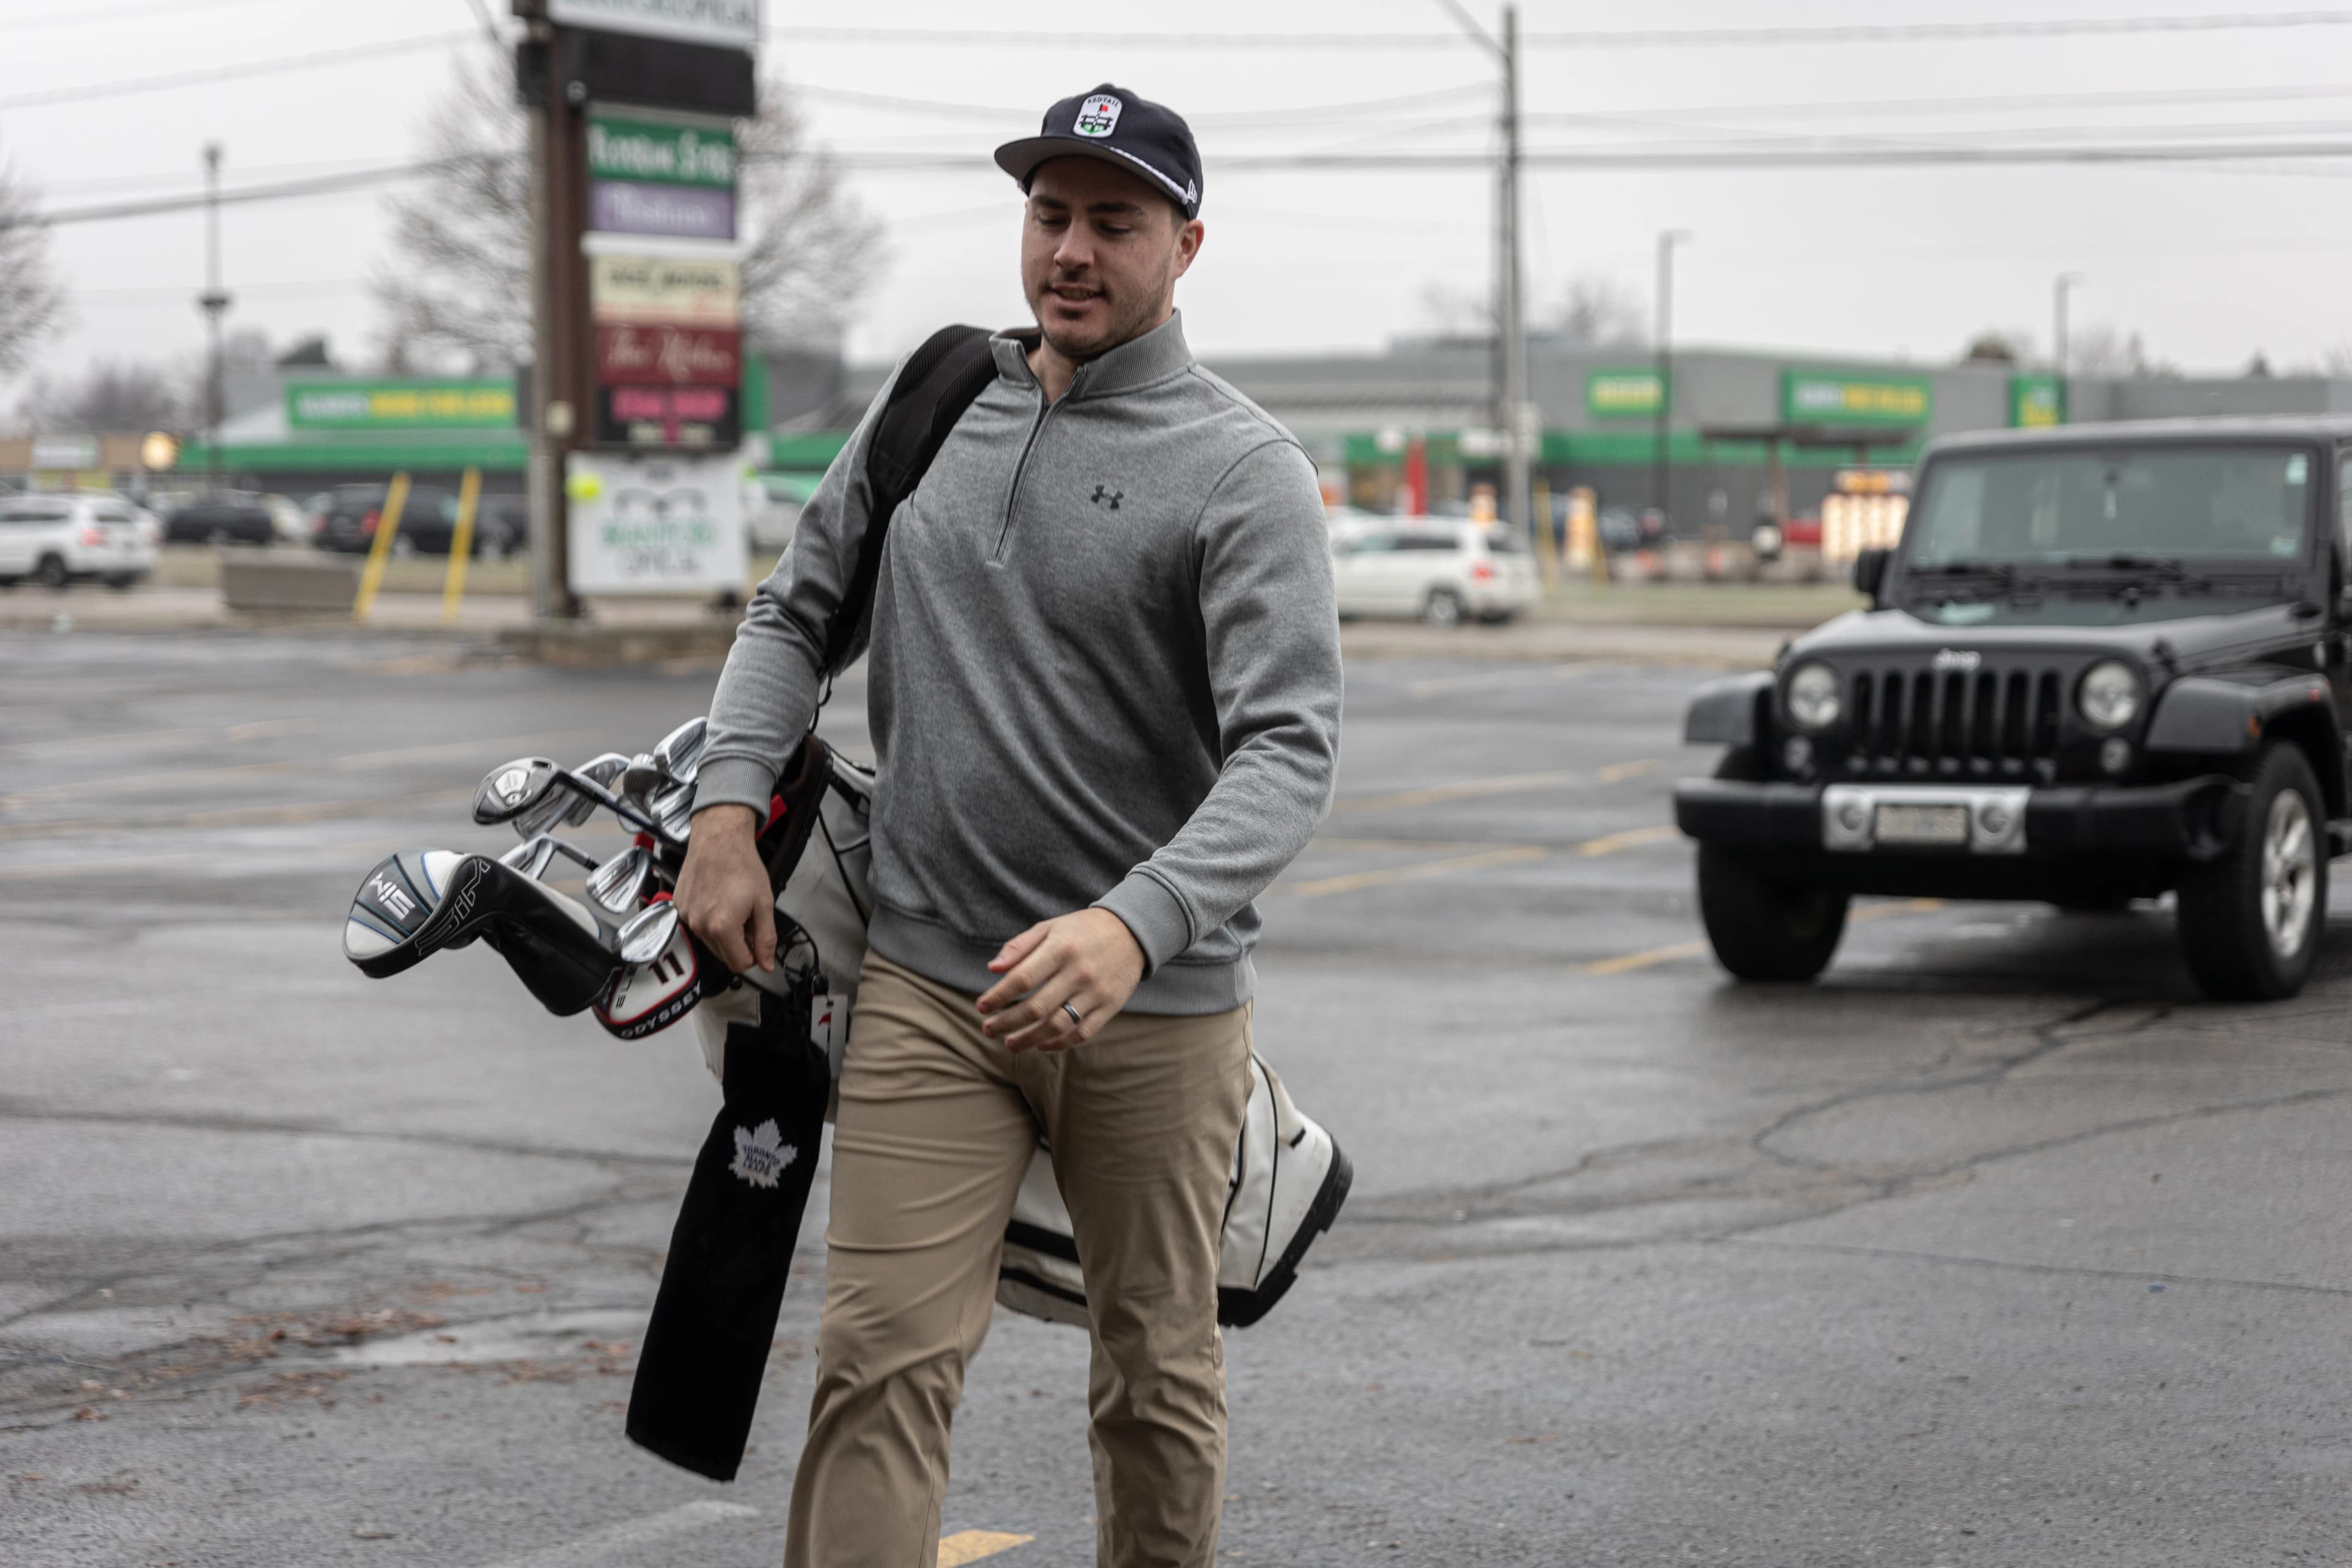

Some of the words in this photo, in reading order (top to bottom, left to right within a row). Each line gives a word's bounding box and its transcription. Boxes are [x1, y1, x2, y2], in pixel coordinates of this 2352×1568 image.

[1088, 97, 1118, 107] REDTAIL
[368, 872, 415, 921] SIM
[647, 951, 685, 986] 11
[621, 980, 701, 1038] ODYSSEY
